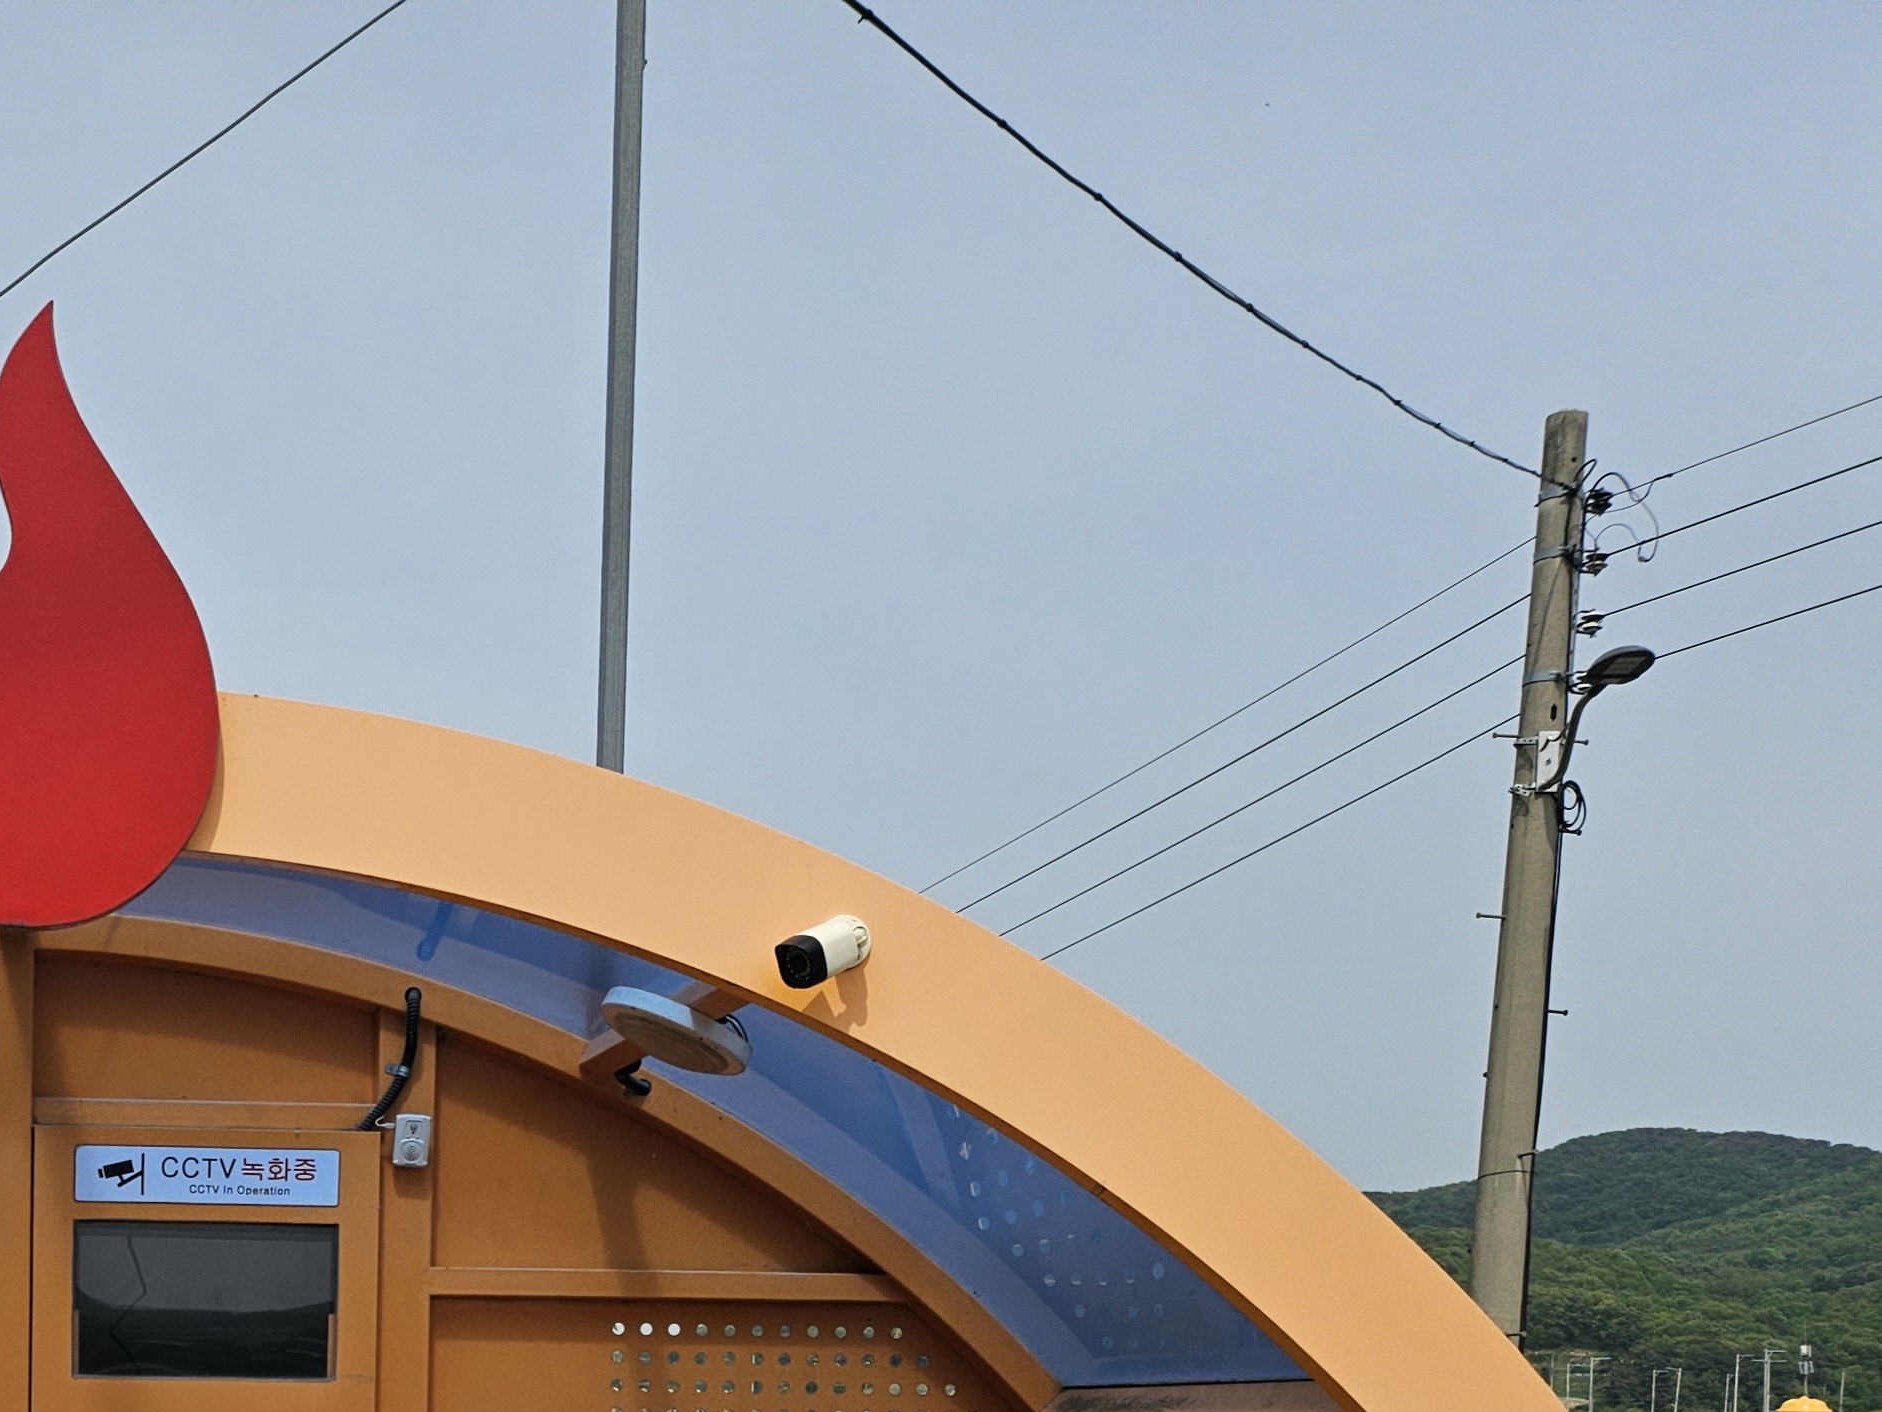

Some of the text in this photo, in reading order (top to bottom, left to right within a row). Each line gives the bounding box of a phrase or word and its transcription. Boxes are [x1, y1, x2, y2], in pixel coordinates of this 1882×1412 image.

[189, 1185, 290, 1195] CCTV In Operation
